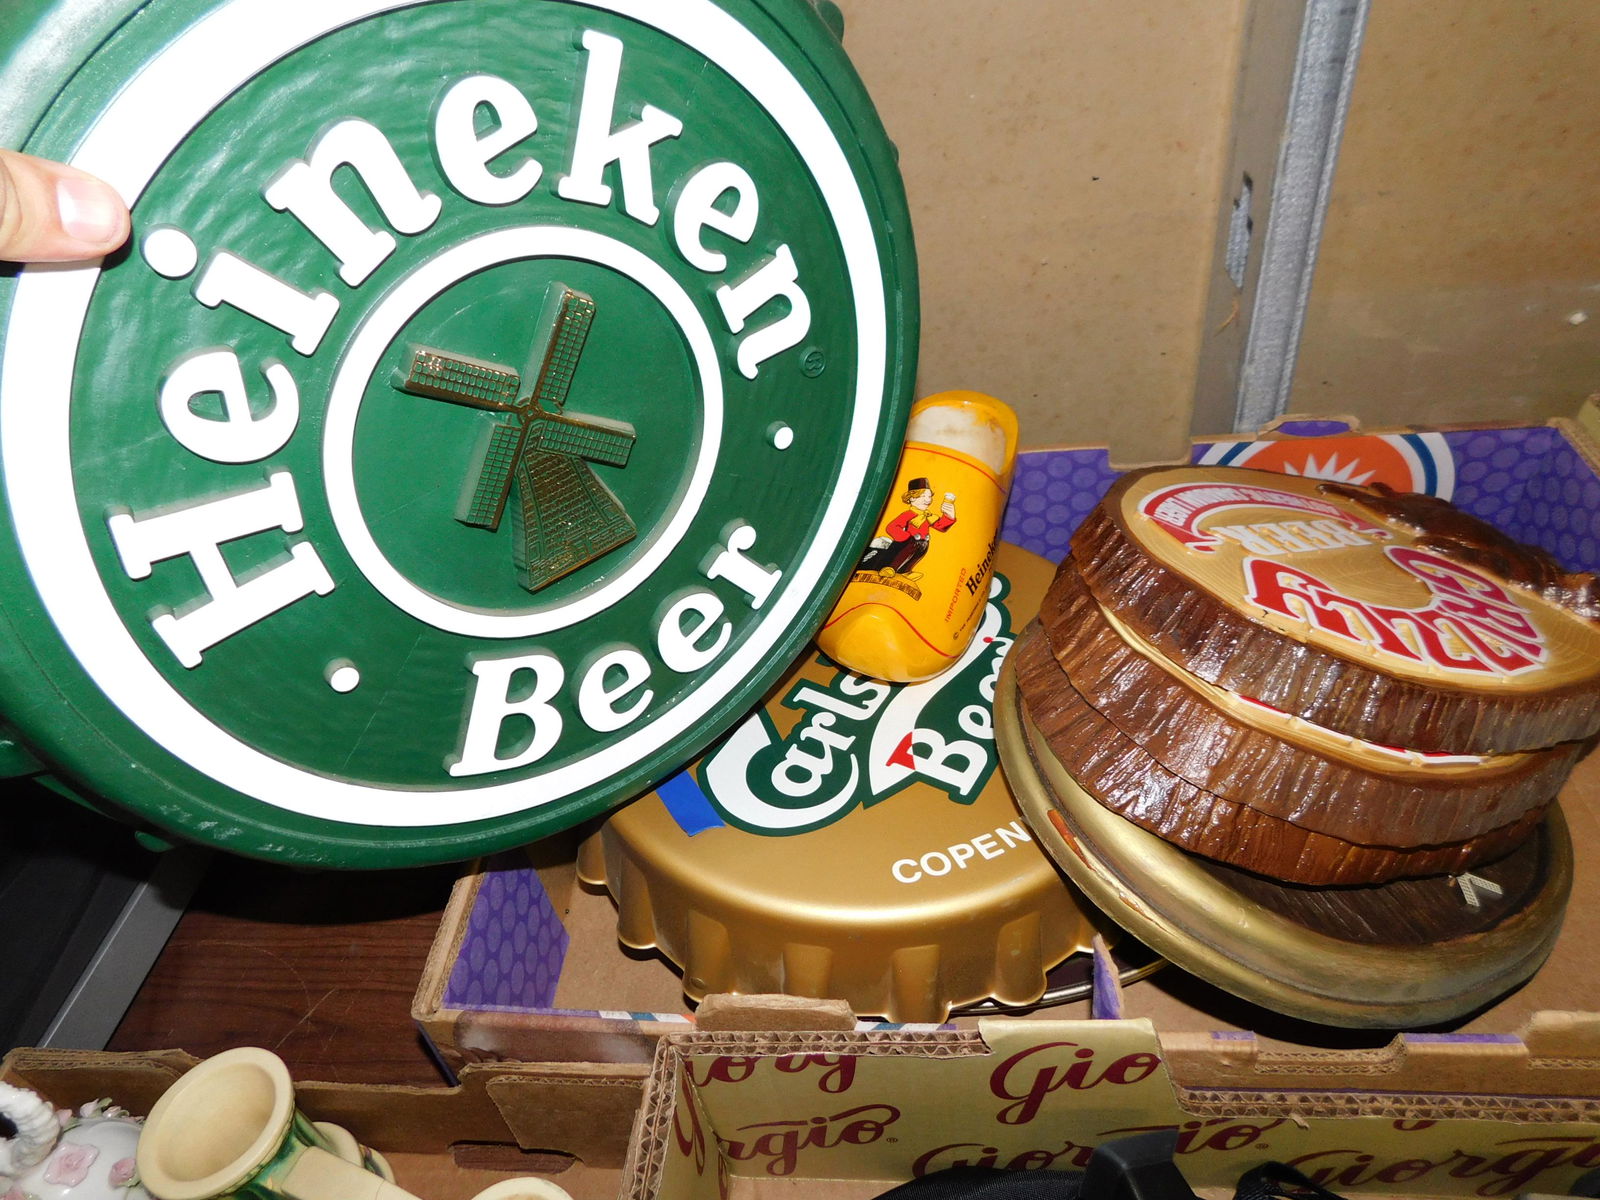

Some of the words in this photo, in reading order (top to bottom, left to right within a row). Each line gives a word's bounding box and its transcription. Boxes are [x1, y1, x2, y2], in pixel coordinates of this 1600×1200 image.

[110, 30, 812, 669] Heineken
[966, 527, 998, 596] Heinek
[1210, 519, 1372, 555] BEER
[945, 567, 968, 623] IMPORTED
[1243, 545, 1548, 677] GRIZZLY
[447, 522, 783, 777] Beer
[891, 821, 1032, 884] COPEN
[718, 1103, 901, 1177] rgio
